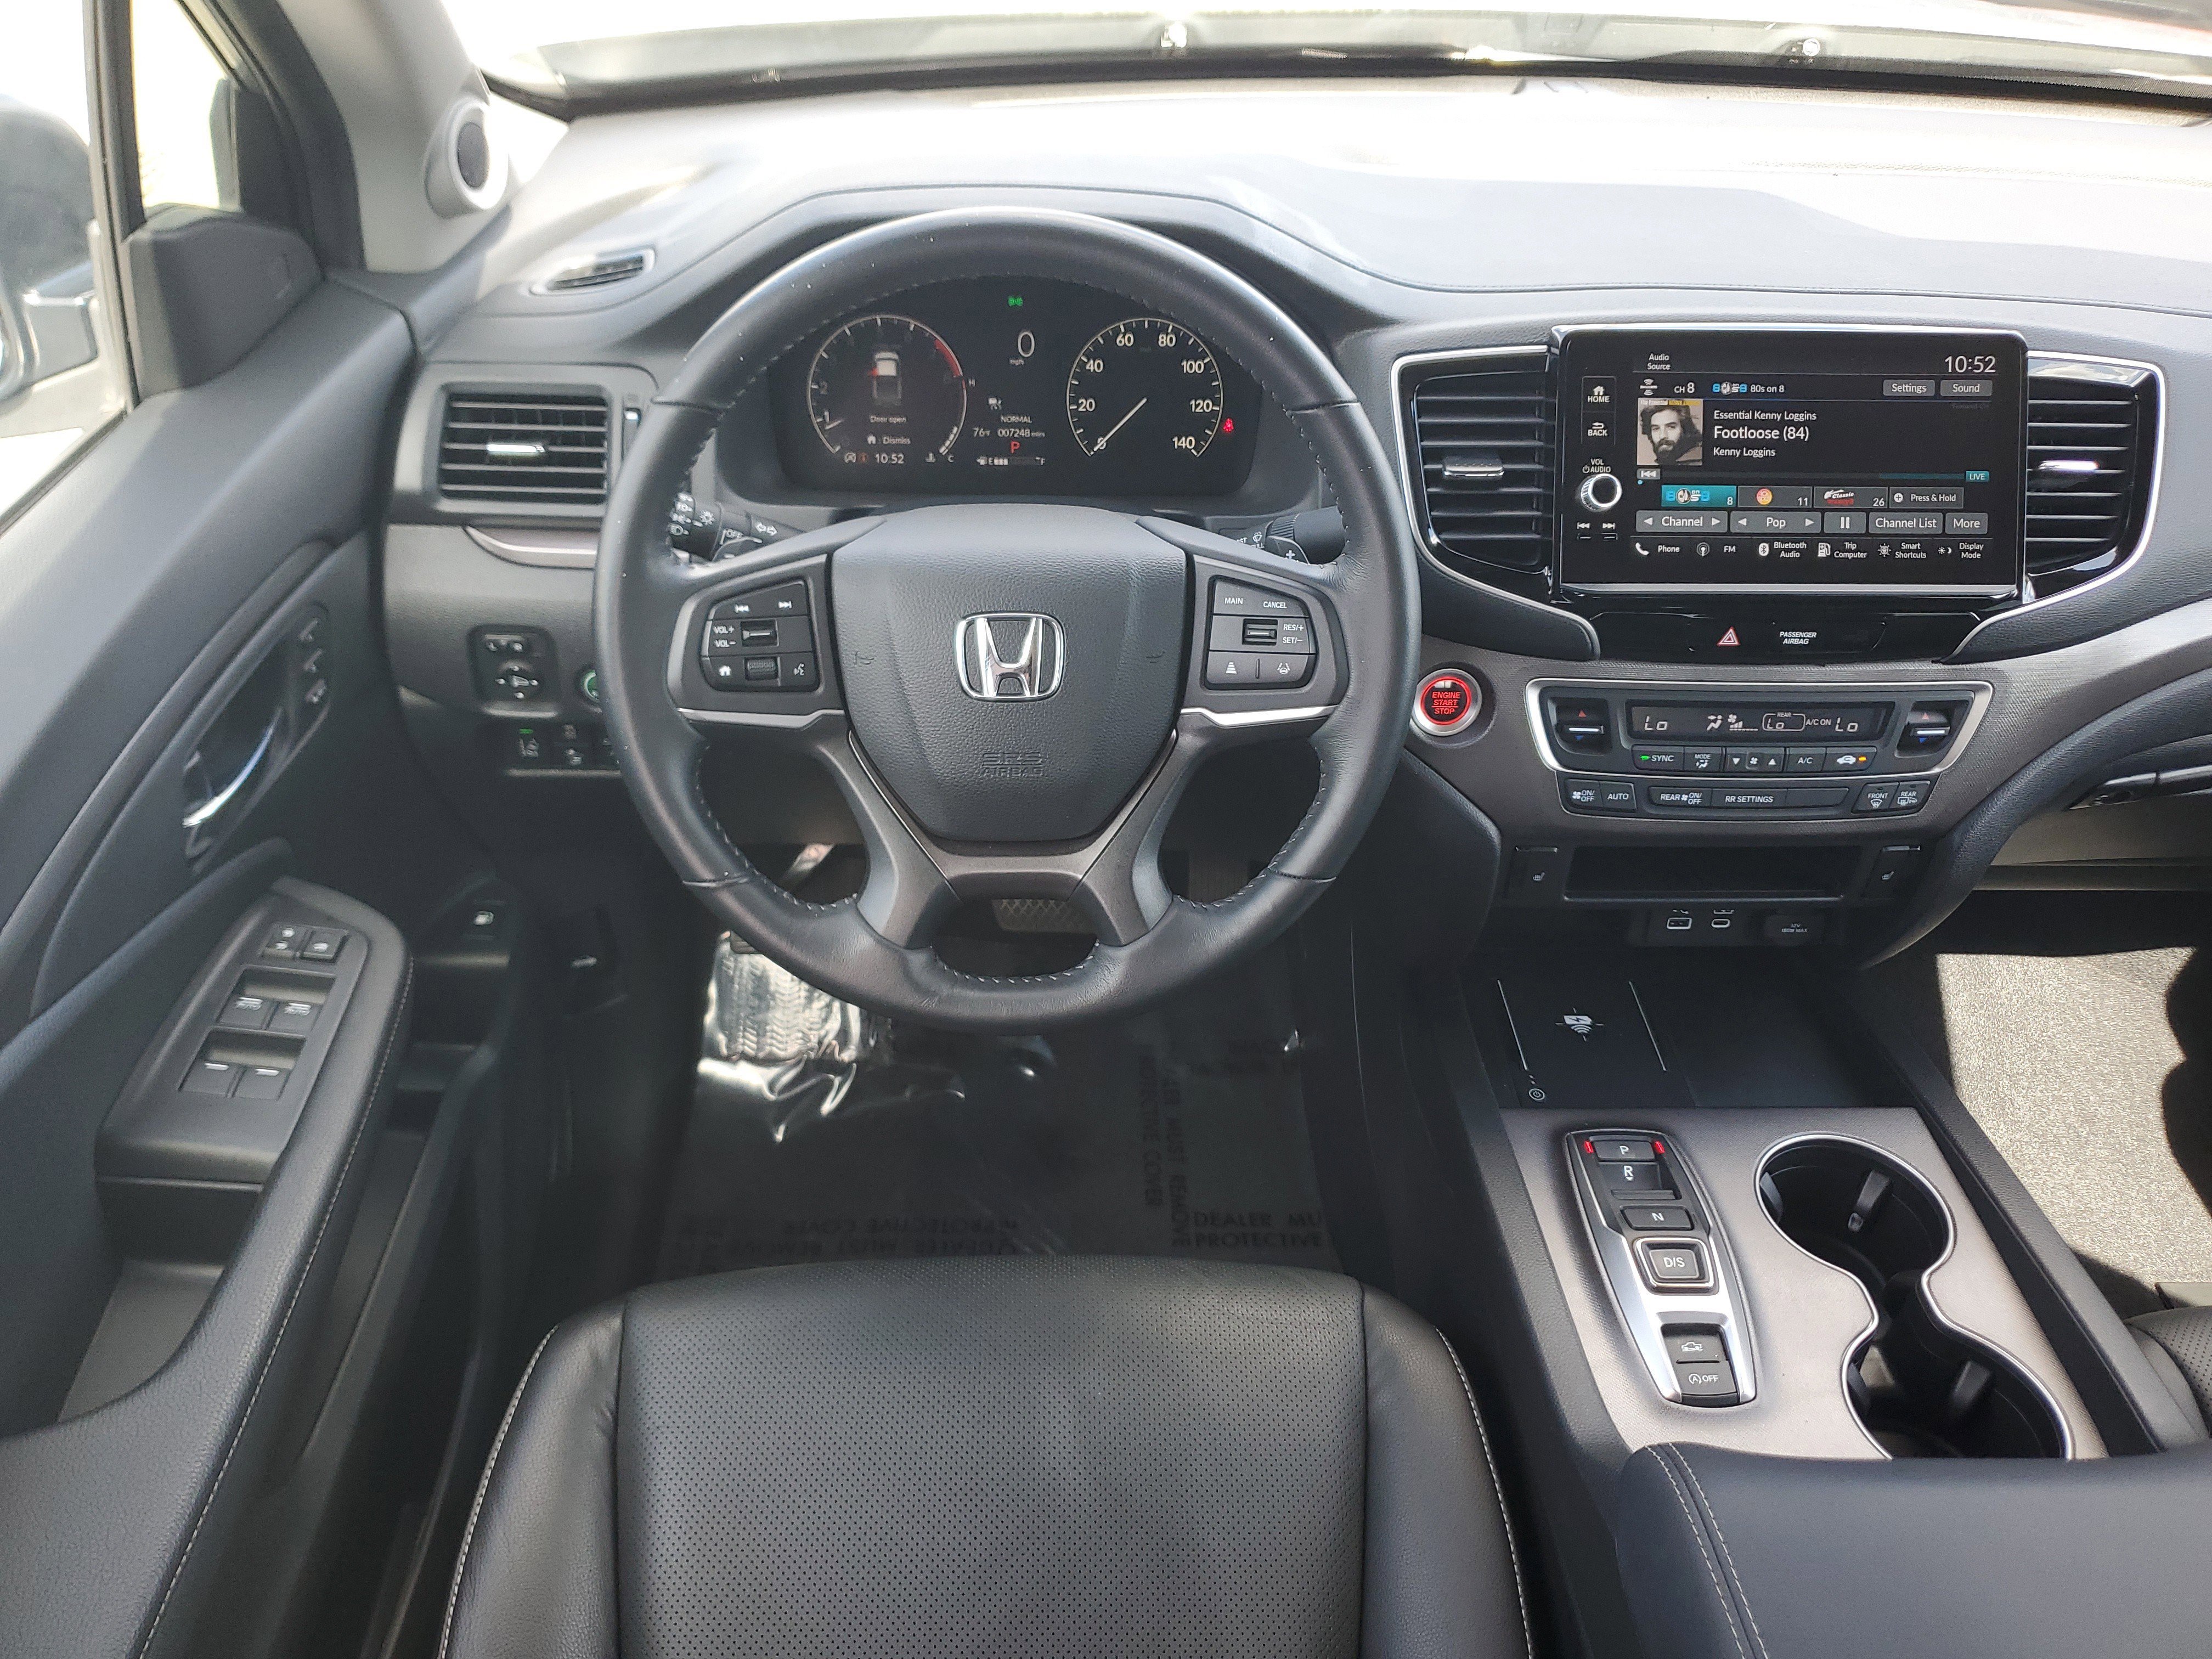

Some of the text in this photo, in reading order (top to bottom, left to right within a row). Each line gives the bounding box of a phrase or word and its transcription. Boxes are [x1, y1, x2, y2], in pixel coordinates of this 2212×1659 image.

[1018, 330, 1035, 357] 0
[1116, 332, 1134, 346] 60
[1158, 333, 1176, 347] 80
[1649, 353, 1669, 361] Audio
[1086, 358, 1104, 373] 40
[1181, 359, 1205, 374] 100
[1944, 356, 1996, 373] 10:52
[1687, 382, 1695, 393] 8
[1750, 385, 1765, 393] 80s
[1891, 382, 1927, 394] Settings
[1952, 383, 1980, 393] Sound
[1077, 398, 1096, 411] 20
[1189, 399, 1213, 413] 120
[1001, 415, 1032, 424] NORMAL
[1714, 410, 1816, 421] Essential Kenny Loggins
[997, 428, 1030, 437] 007248
[1714, 426, 1809, 441] Footloose (84)
[1010, 441, 1021, 453] P
[1172, 436, 1196, 449] 140
[1713, 447, 1775, 458] Kenny Loggins
[875, 453, 905, 464] 10:52
[1727, 496, 1733, 506] 8
[1797, 498, 1808, 506] 11
[1873, 498, 1884, 507] 26
[1661, 516, 1703, 527] Channel
[1766, 517, 1786, 529] Pop
[1875, 518, 1937, 528] Channel List
[1953, 518, 1980, 529] More
[1658, 545, 1680, 553] Phone
[1844, 542, 1857, 550] Trip
[1959, 543, 1984, 551] Display
[1780, 550, 1800, 558] Audio
[1834, 551, 1867, 560] Computer
[1644, 715, 1668, 731] Lo
[1835, 717, 1859, 732] Lo
[1620, 1146, 1629, 1155] P
[1624, 1166, 1633, 1177] R
[1652, 1212, 1664, 1221] N
[1663, 1257, 1685, 1268] D/S
